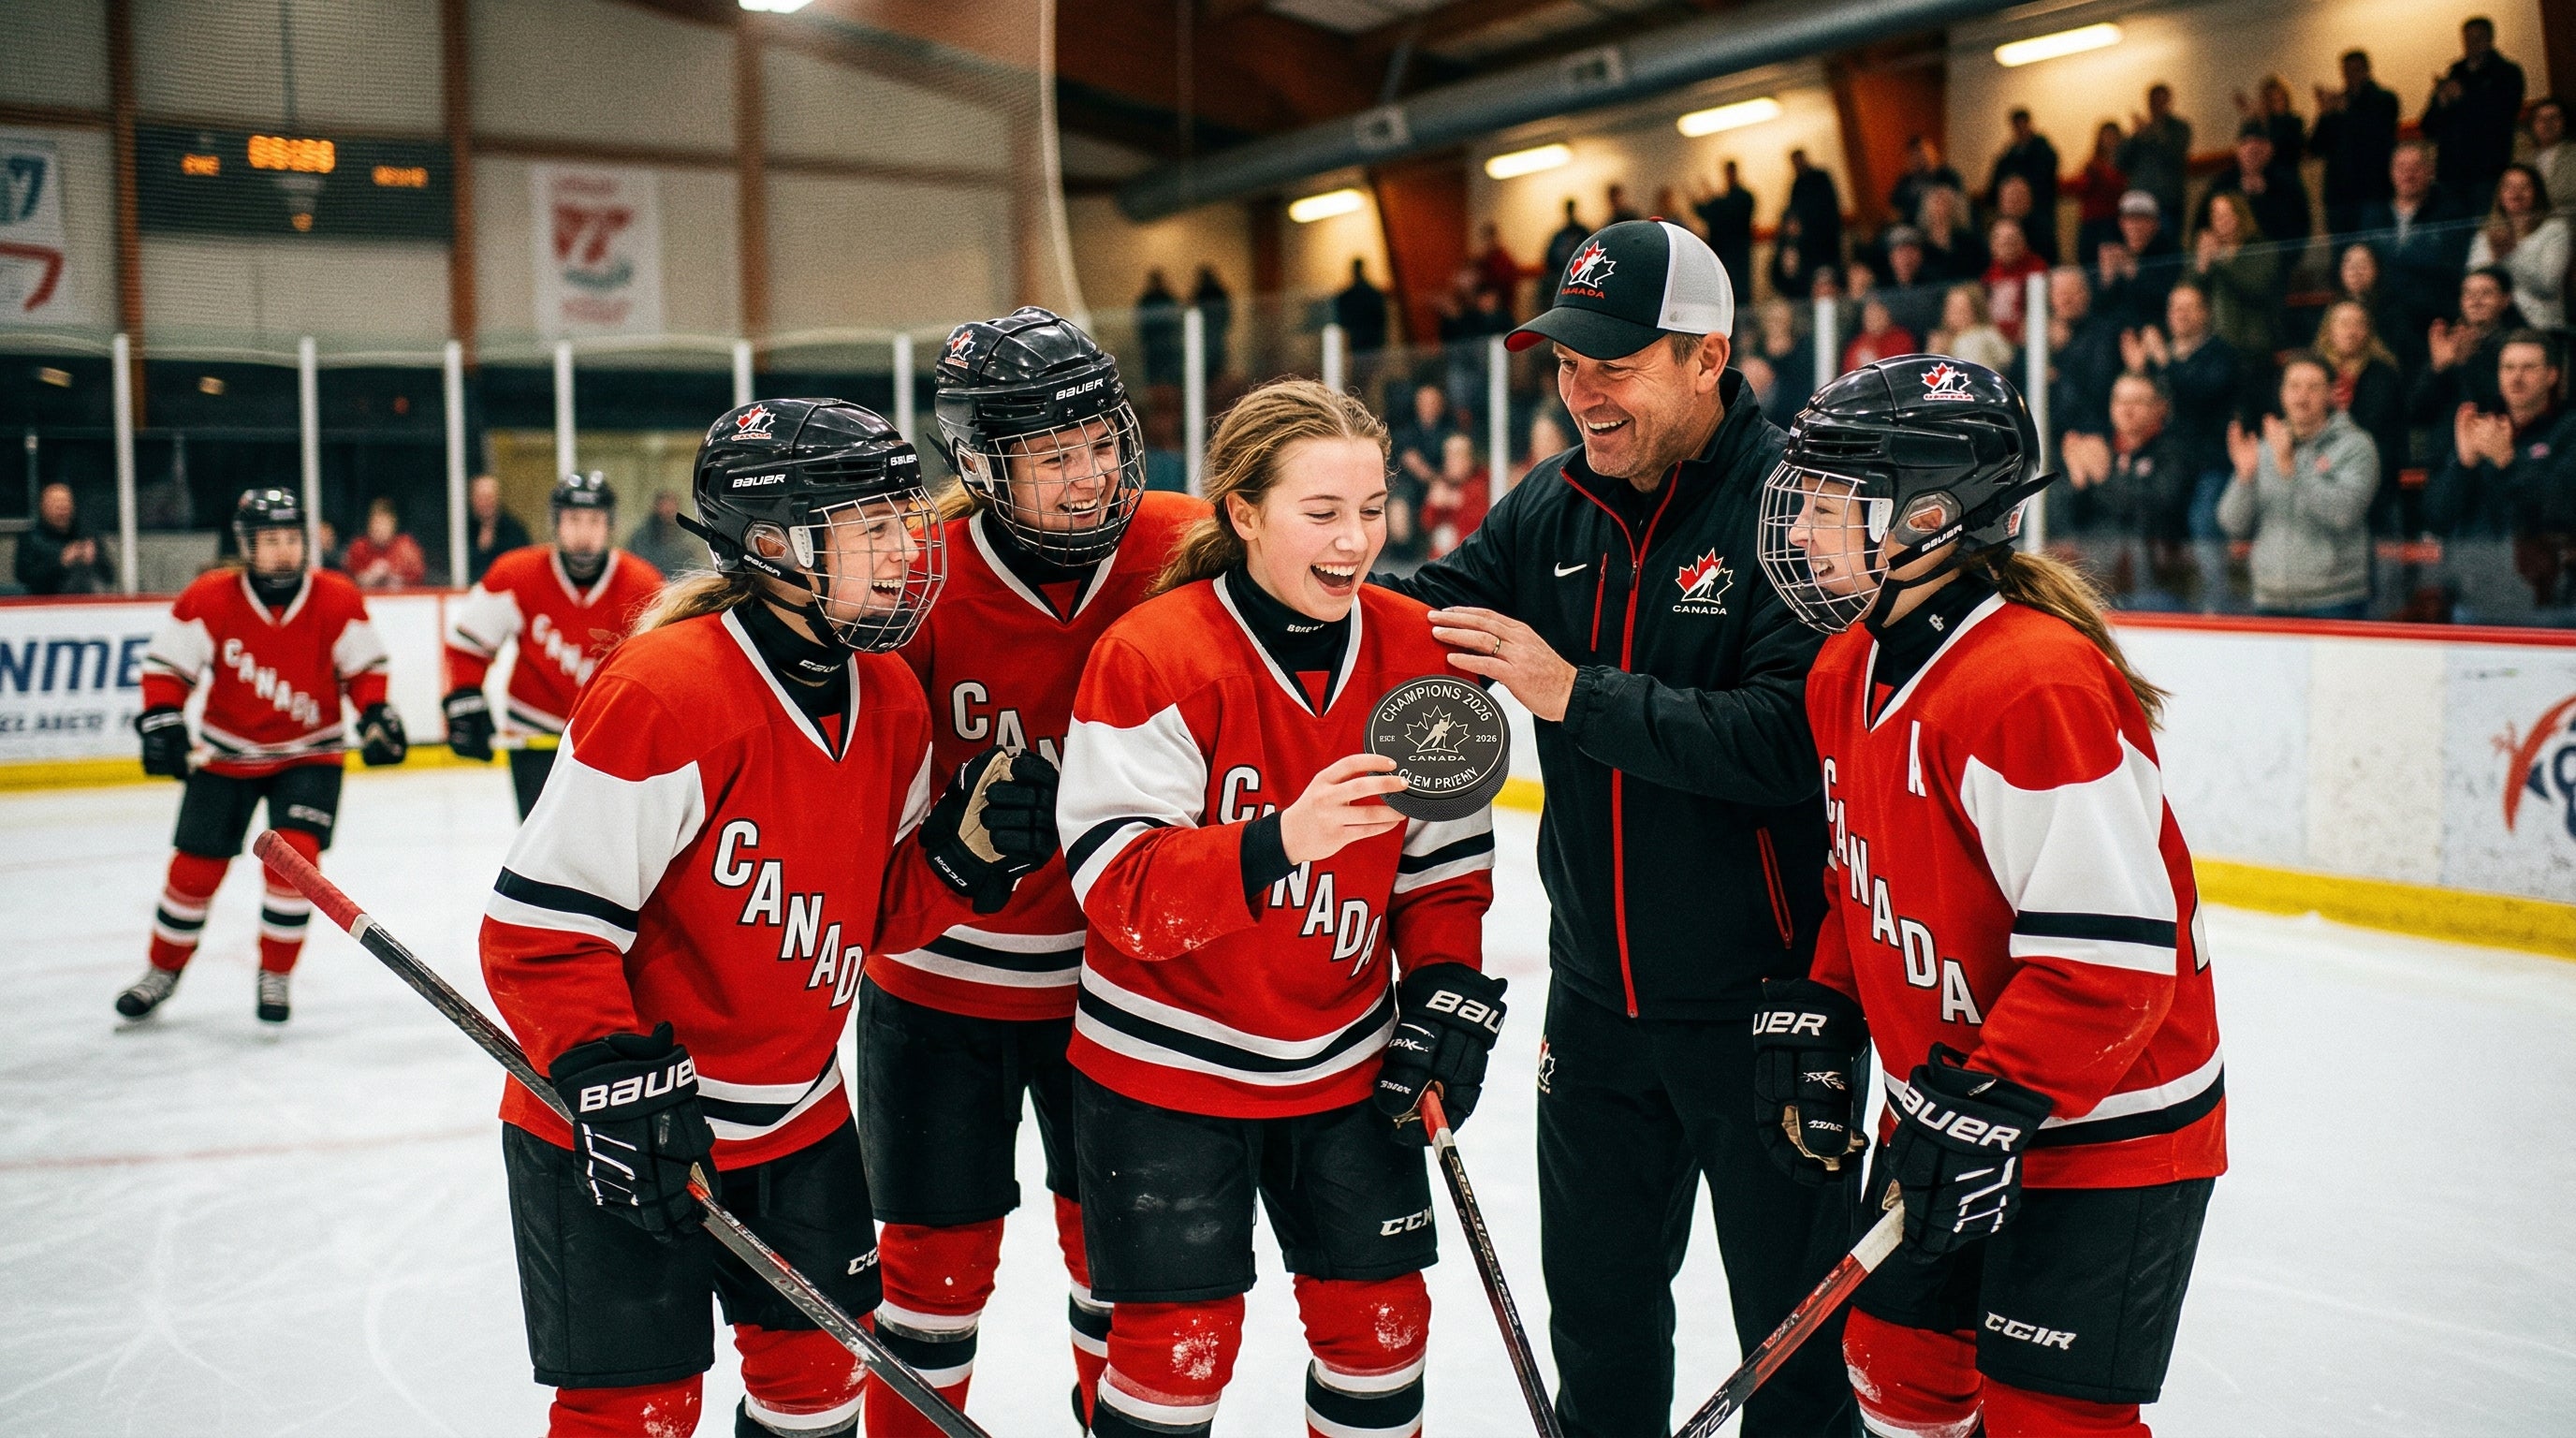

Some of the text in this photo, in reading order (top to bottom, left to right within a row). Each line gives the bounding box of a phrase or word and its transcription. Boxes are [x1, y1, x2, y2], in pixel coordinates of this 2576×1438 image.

[1055, 377, 1104, 401] BAUER
[732, 474, 786, 489] BAUER
[1672, 605, 1727, 615] CANADA
[1382, 684, 1493, 722] CHAMPIONS 2026
[1475, 734, 1498, 742] 2026
[1398, 768, 1431, 788] CLEM
[1219, 765, 1383, 977] CNADA
[1823, 757, 1983, 1024] CANADA
[579, 1056, 697, 1113] BAUE
